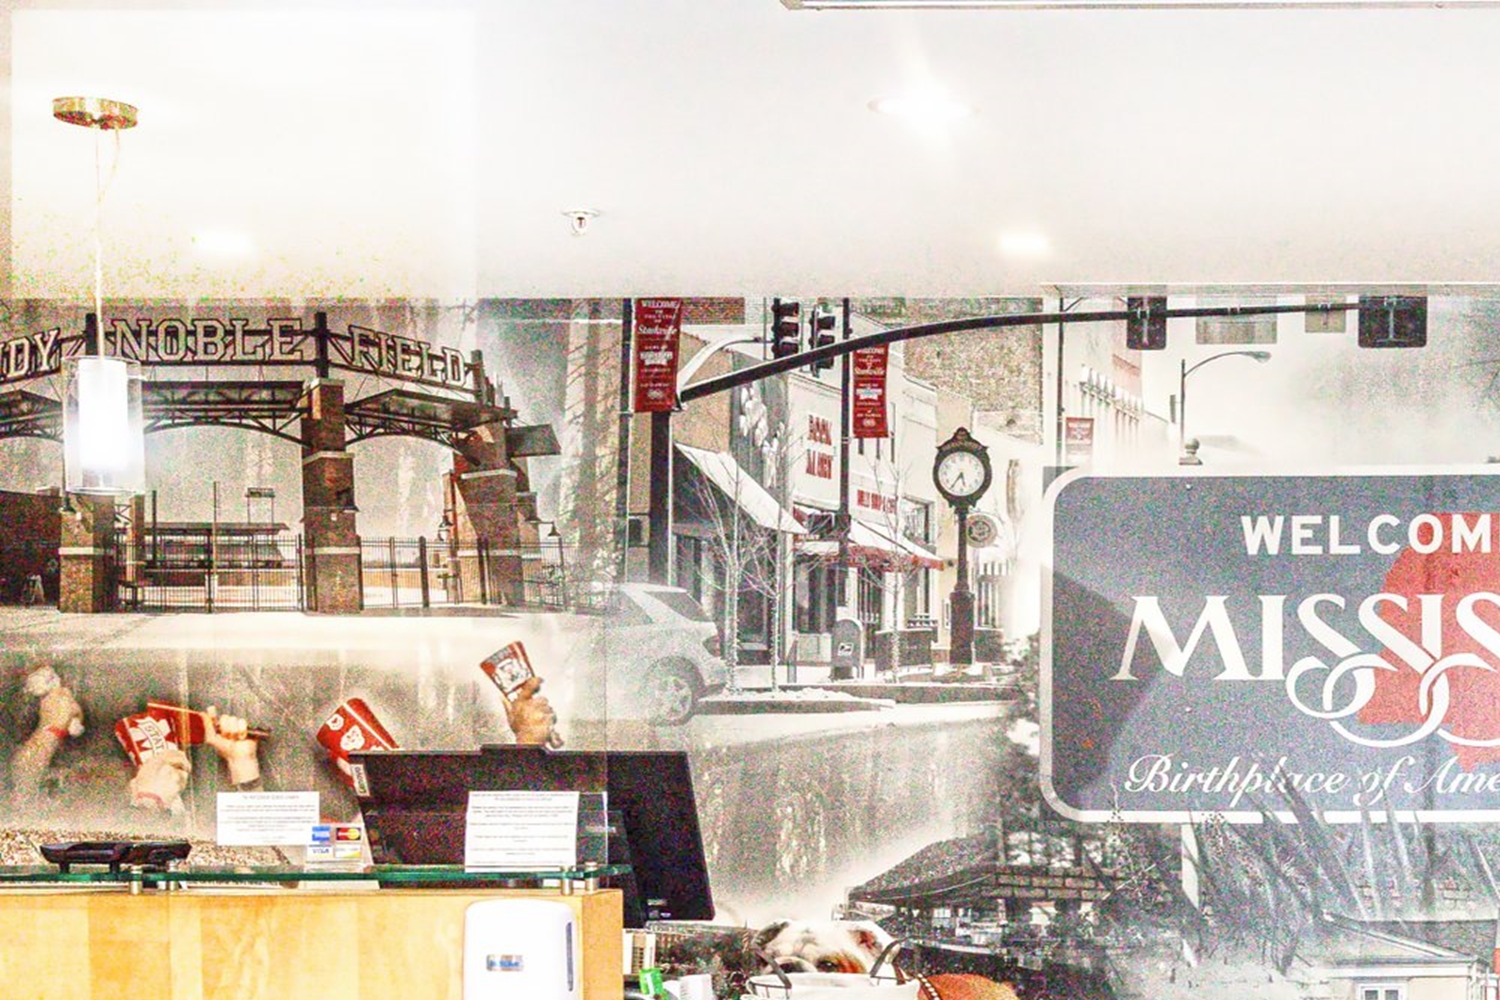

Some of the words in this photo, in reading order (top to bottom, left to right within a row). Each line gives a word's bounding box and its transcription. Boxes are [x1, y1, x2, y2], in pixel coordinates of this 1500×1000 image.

[111, 318, 304, 362] NOBLE
[348, 324, 467, 388] FIELD
[1124, 754, 1350, 808] Birthplace
[1353, 755, 1415, 806] of
